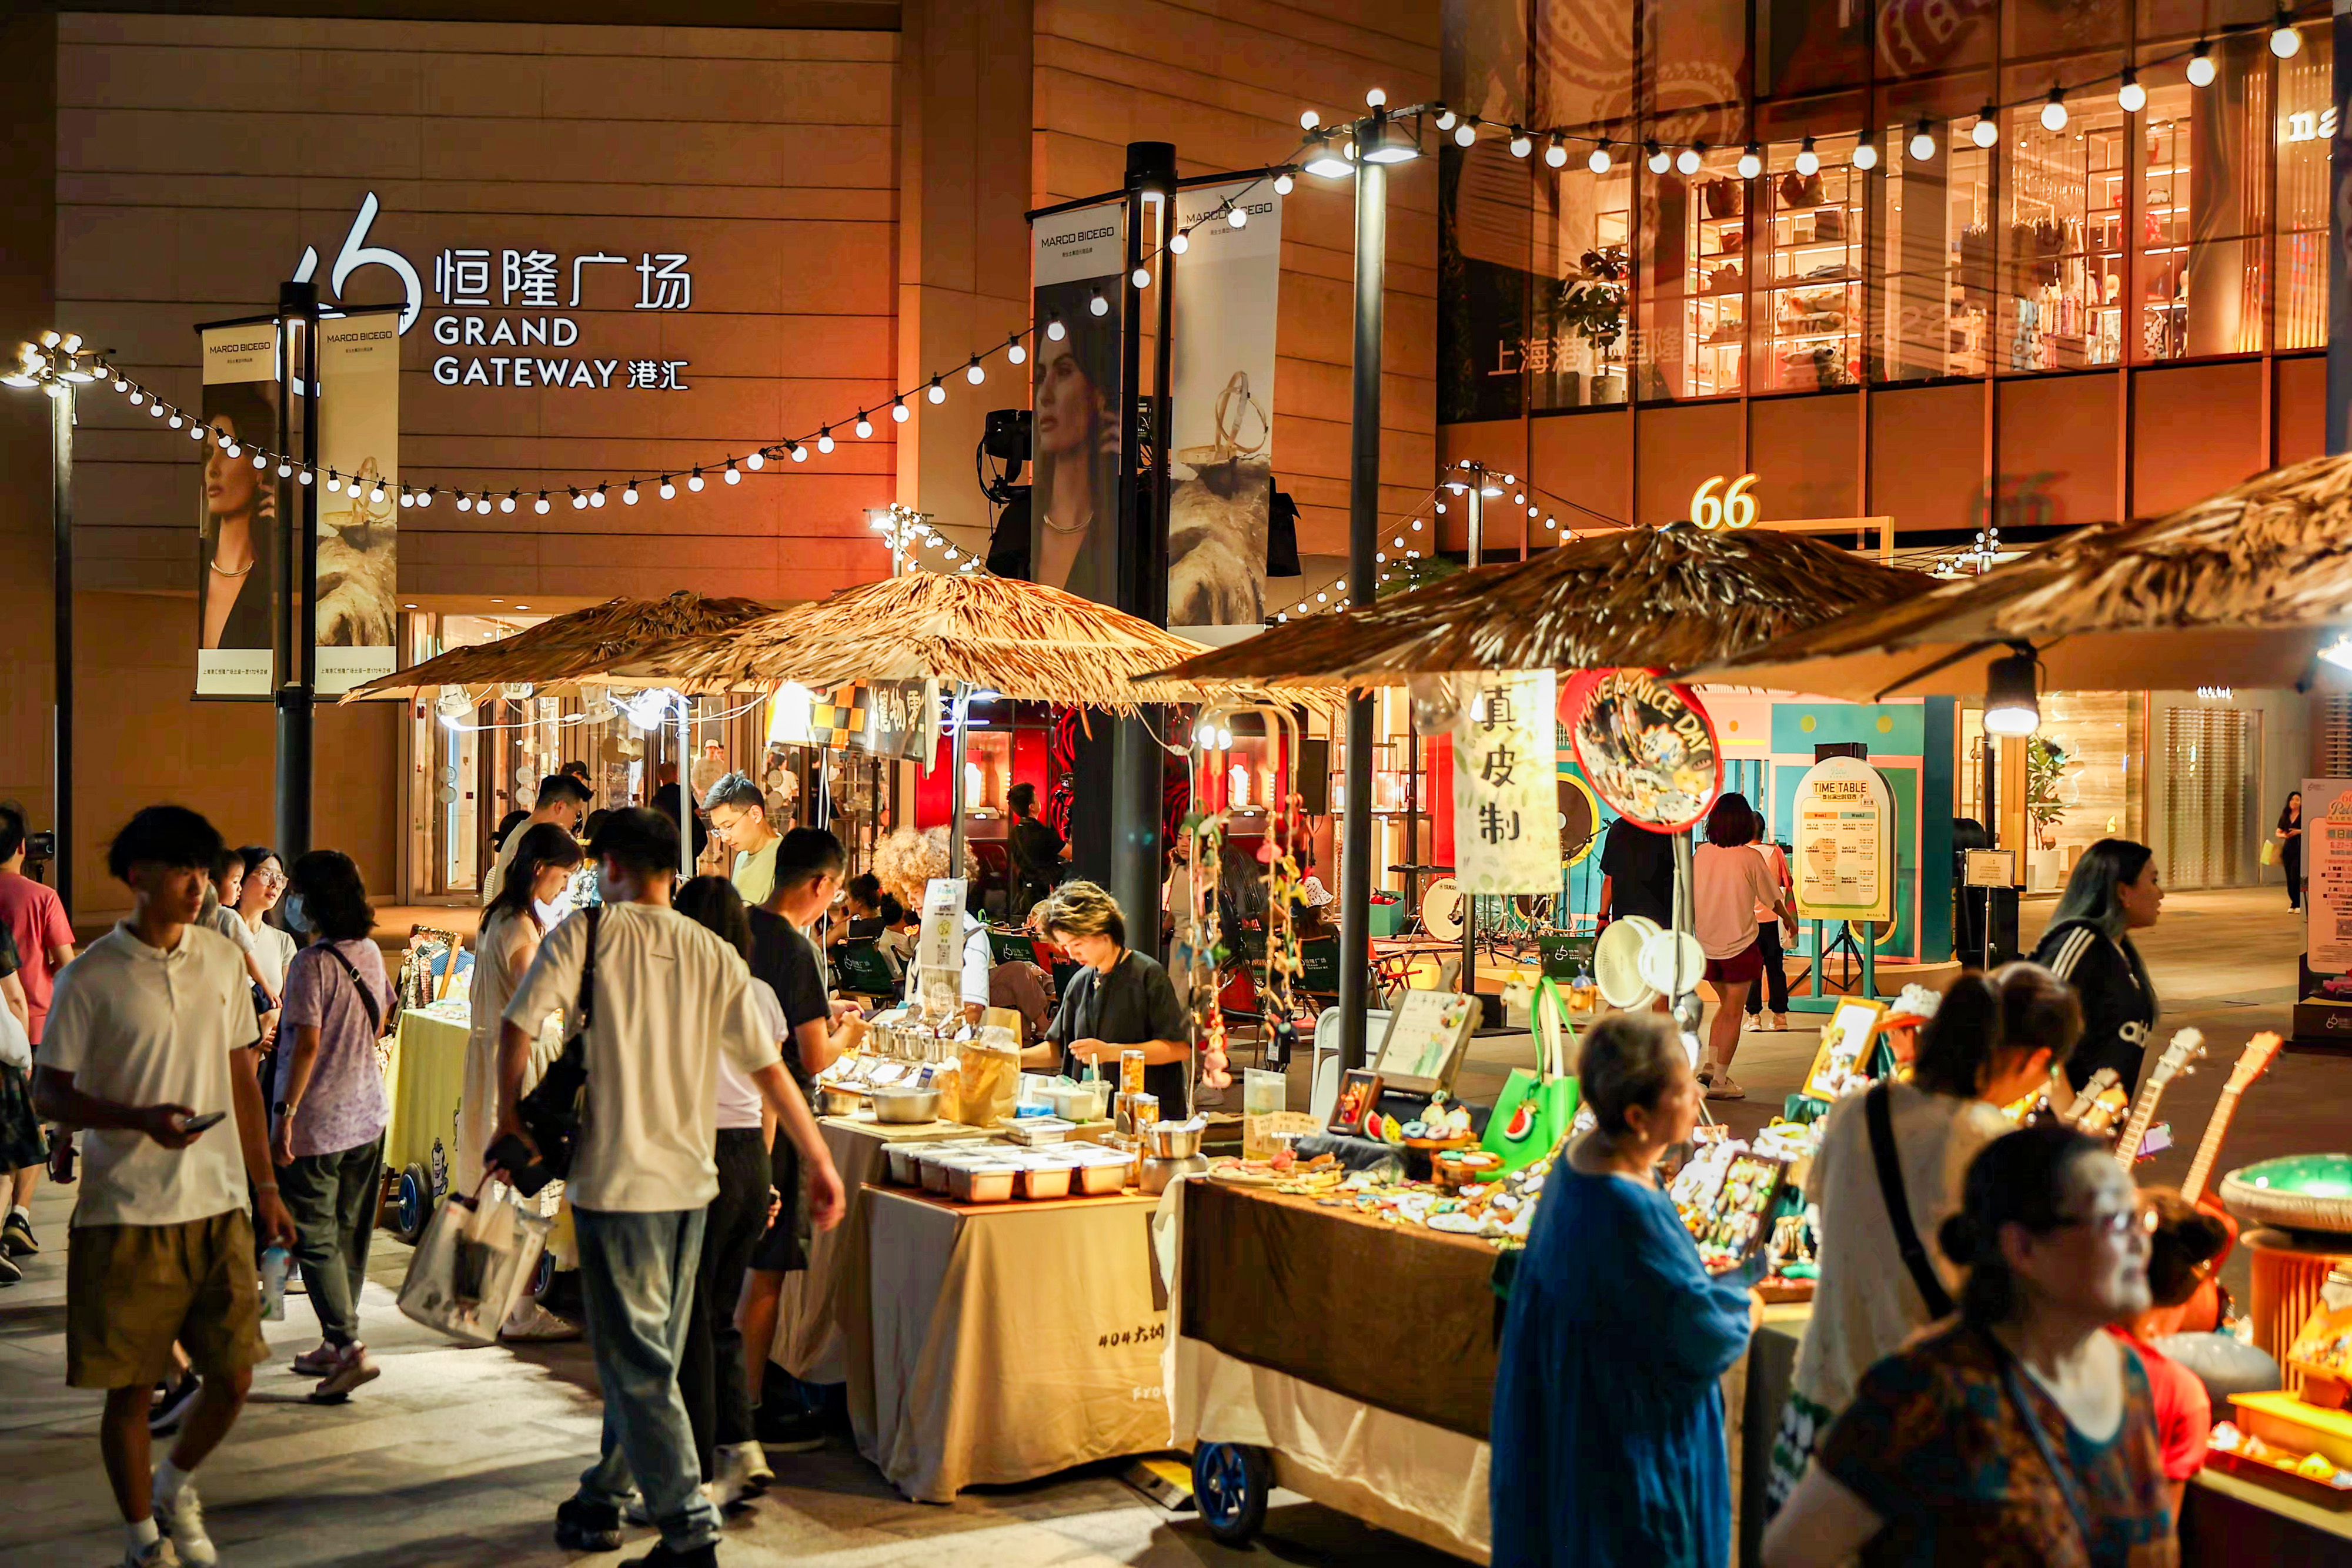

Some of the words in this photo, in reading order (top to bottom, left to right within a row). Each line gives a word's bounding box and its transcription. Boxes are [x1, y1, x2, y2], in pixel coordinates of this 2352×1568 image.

[1186, 209, 1227, 225] MARCO
[1041, 233, 1075, 248] MARCO
[1078, 226, 1114, 242] BICEGO
[435, 249, 691, 310] 恒隆广场
[327, 333, 358, 343] MARCO
[360, 330, 392, 340] BICEGO
[433, 316, 578, 347] GRAND
[209, 345, 239, 354] MARCO
[240, 342, 270, 352] BICEGO
[433, 356, 618, 389] GATEWAY
[627, 360, 689, 390] 港汇
[1689, 473, 1758, 530] 66
[1576, 676, 1613, 726] HAVE
[1613, 671, 1626, 695] A
[1627, 674, 1682, 718] NICE
[1673, 711, 1711, 754] DAY
[1813, 783, 1835, 793] TIME
[1838, 783, 1867, 793] TABLE
